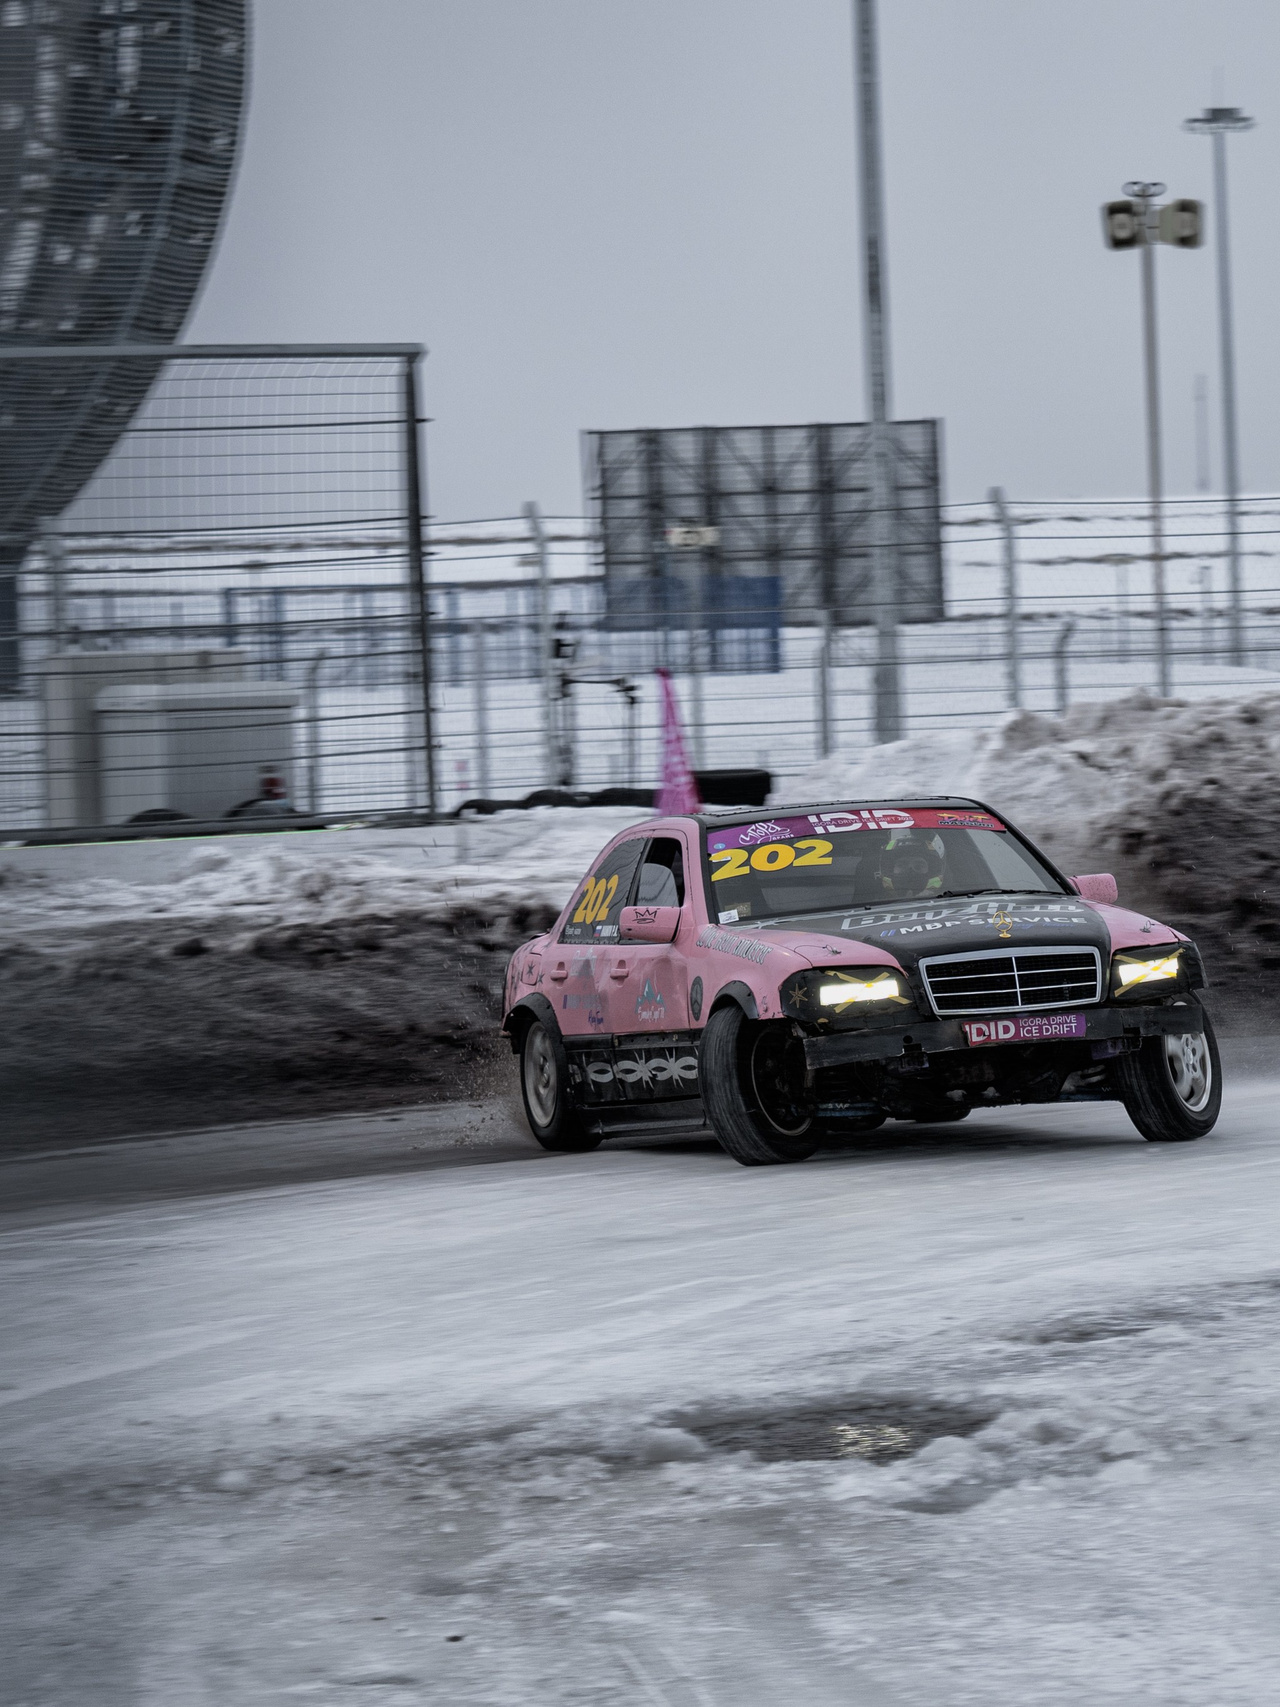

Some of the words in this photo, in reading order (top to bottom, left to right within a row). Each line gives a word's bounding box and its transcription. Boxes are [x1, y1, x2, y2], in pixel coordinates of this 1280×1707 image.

[808, 809, 914, 834] IDID
[709, 839, 834, 882] 202
[572, 874, 619, 925] 202
[968, 917, 1088, 926] SERVICE
[965, 1020, 1016, 1042] IDID
[1020, 1017, 1048, 1027] IGORA
[1050, 1015, 1077, 1025] DRIVE
[1020, 1026, 1039, 1037] ICE
[1043, 1023, 1077, 1036] DRIFT
